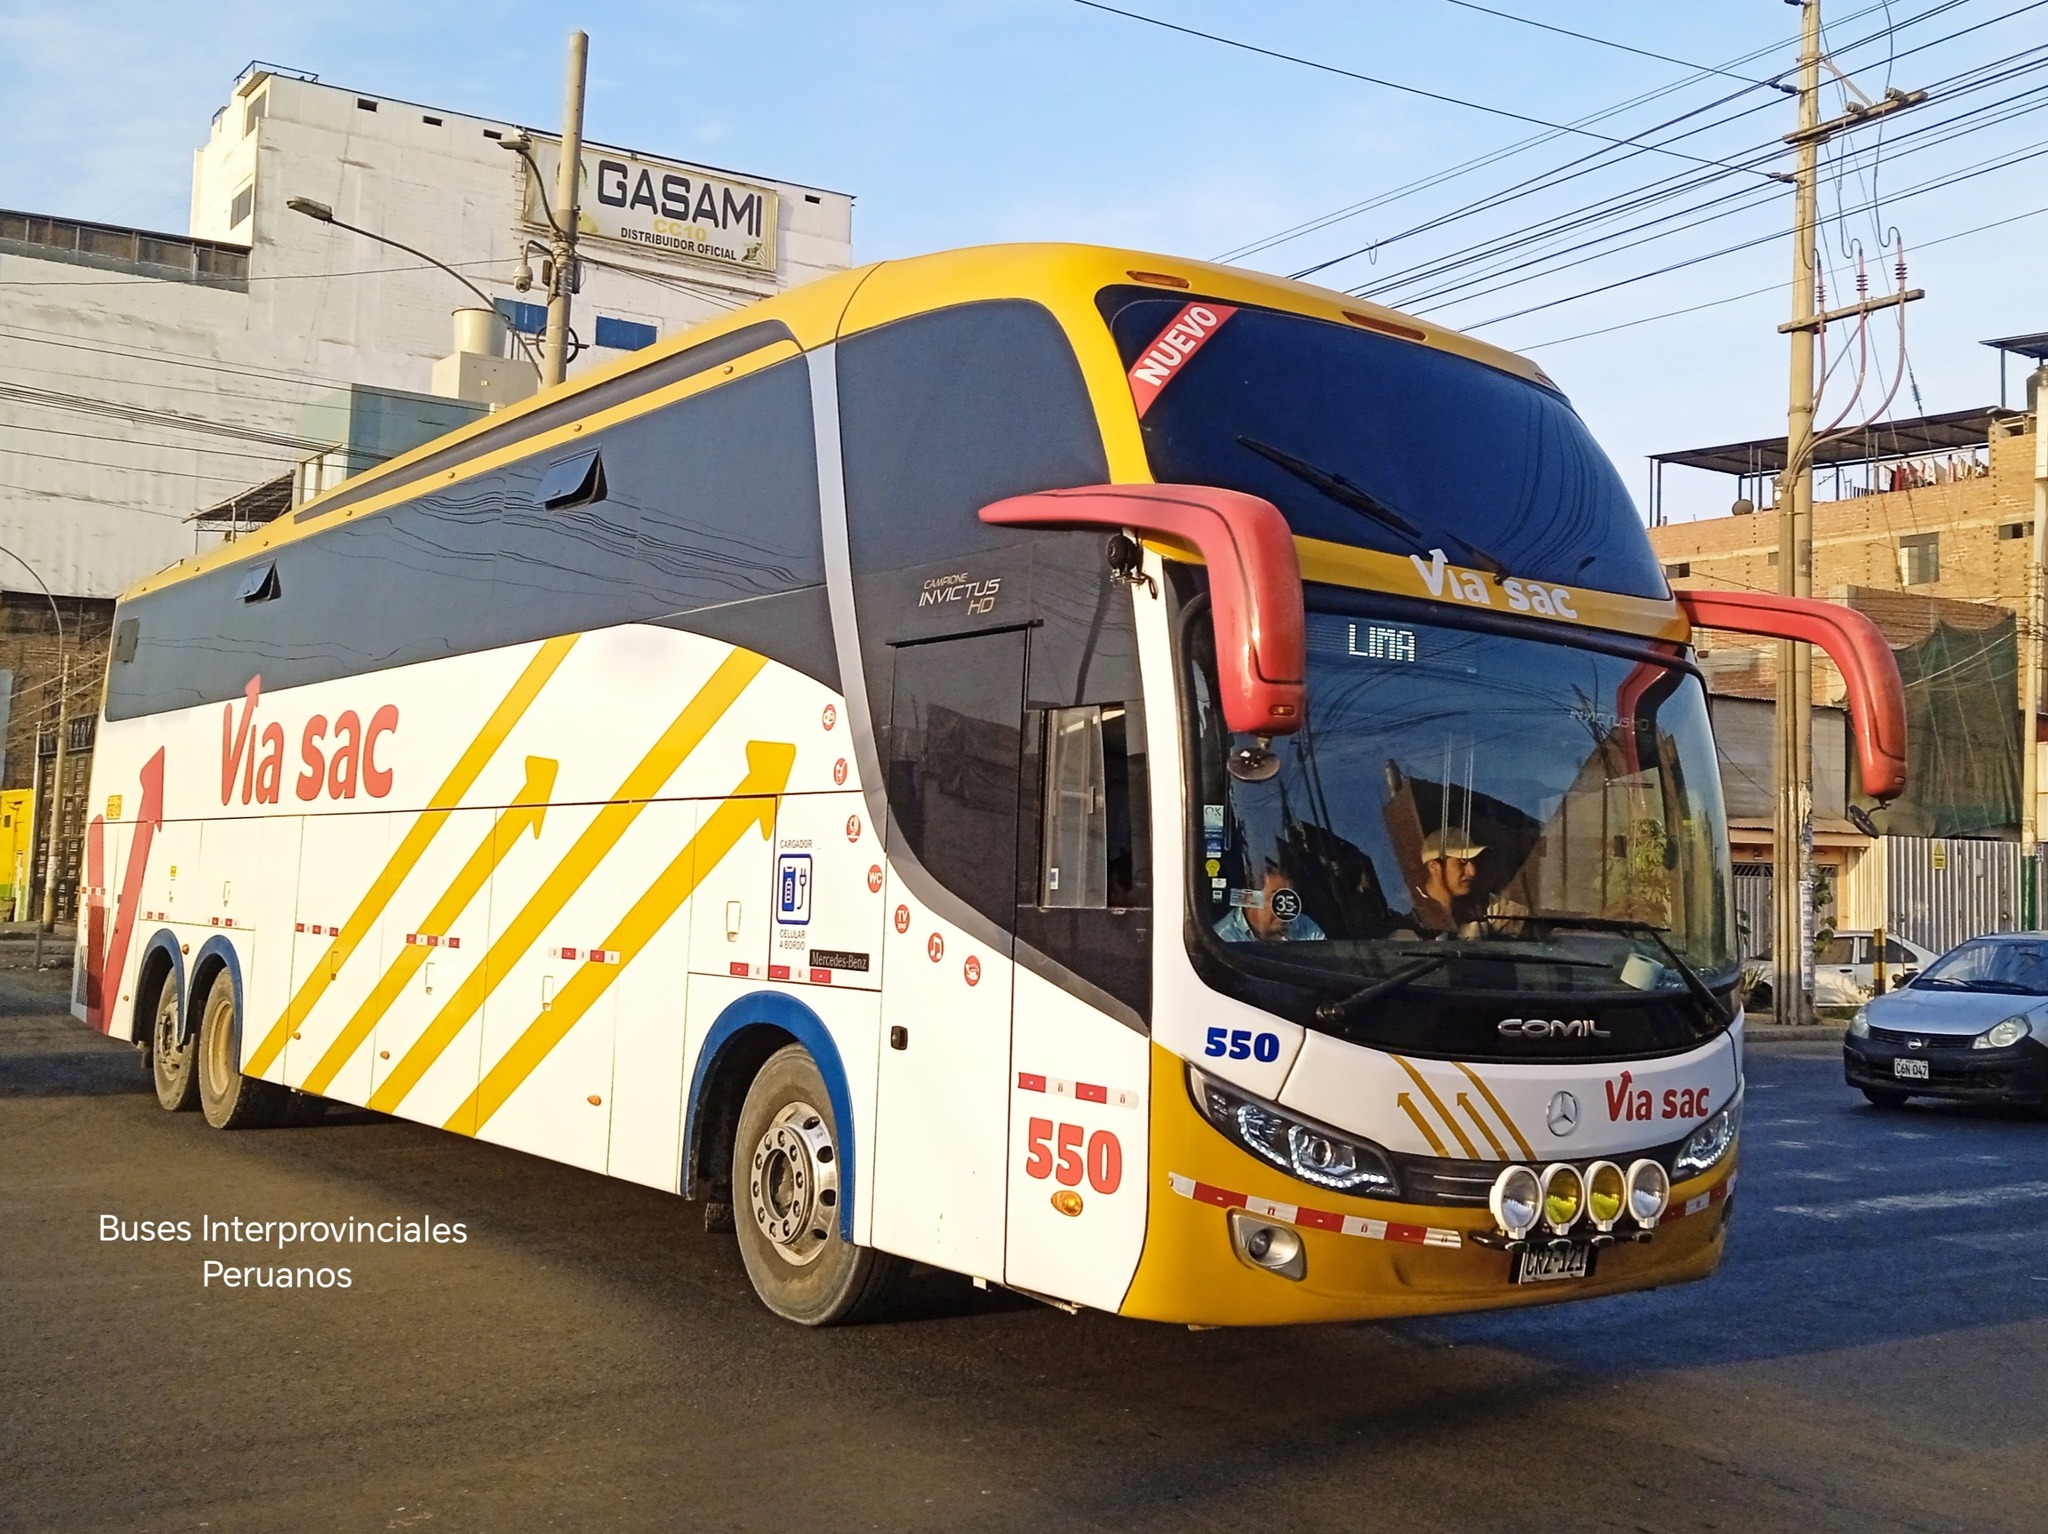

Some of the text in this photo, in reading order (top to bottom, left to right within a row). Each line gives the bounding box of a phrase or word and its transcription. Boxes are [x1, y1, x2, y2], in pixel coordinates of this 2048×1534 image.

[598, 159, 762, 237] GASAMI
[620, 226, 737, 261] DISTRIBUIDOR OFICIAL
[1133, 306, 1218, 387] NUEVO
[918, 578, 1001, 607] INVICTUS
[923, 572, 968, 589] CAMPIONE
[967, 597, 995, 615] HD
[1503, 579, 1578, 619] sac
[1348, 624, 1415, 662] LIMA
[295, 704, 399, 801] sac
[780, 839, 813, 849] CARGADOR
[869, 872, 882, 884] WC
[897, 909, 909, 922] TV
[1276, 895, 1297, 912] 35
[779, 929, 806, 939] CELULAR
[779, 940, 805, 951] A BORDO
[811, 951, 867, 970] Mercedes-Benz
[1498, 1018, 1611, 1038] COMIL
[1204, 1026, 1280, 1063] 550
[1661, 1087, 1710, 1119] sac
[1025, 1116, 1123, 1195] 550
